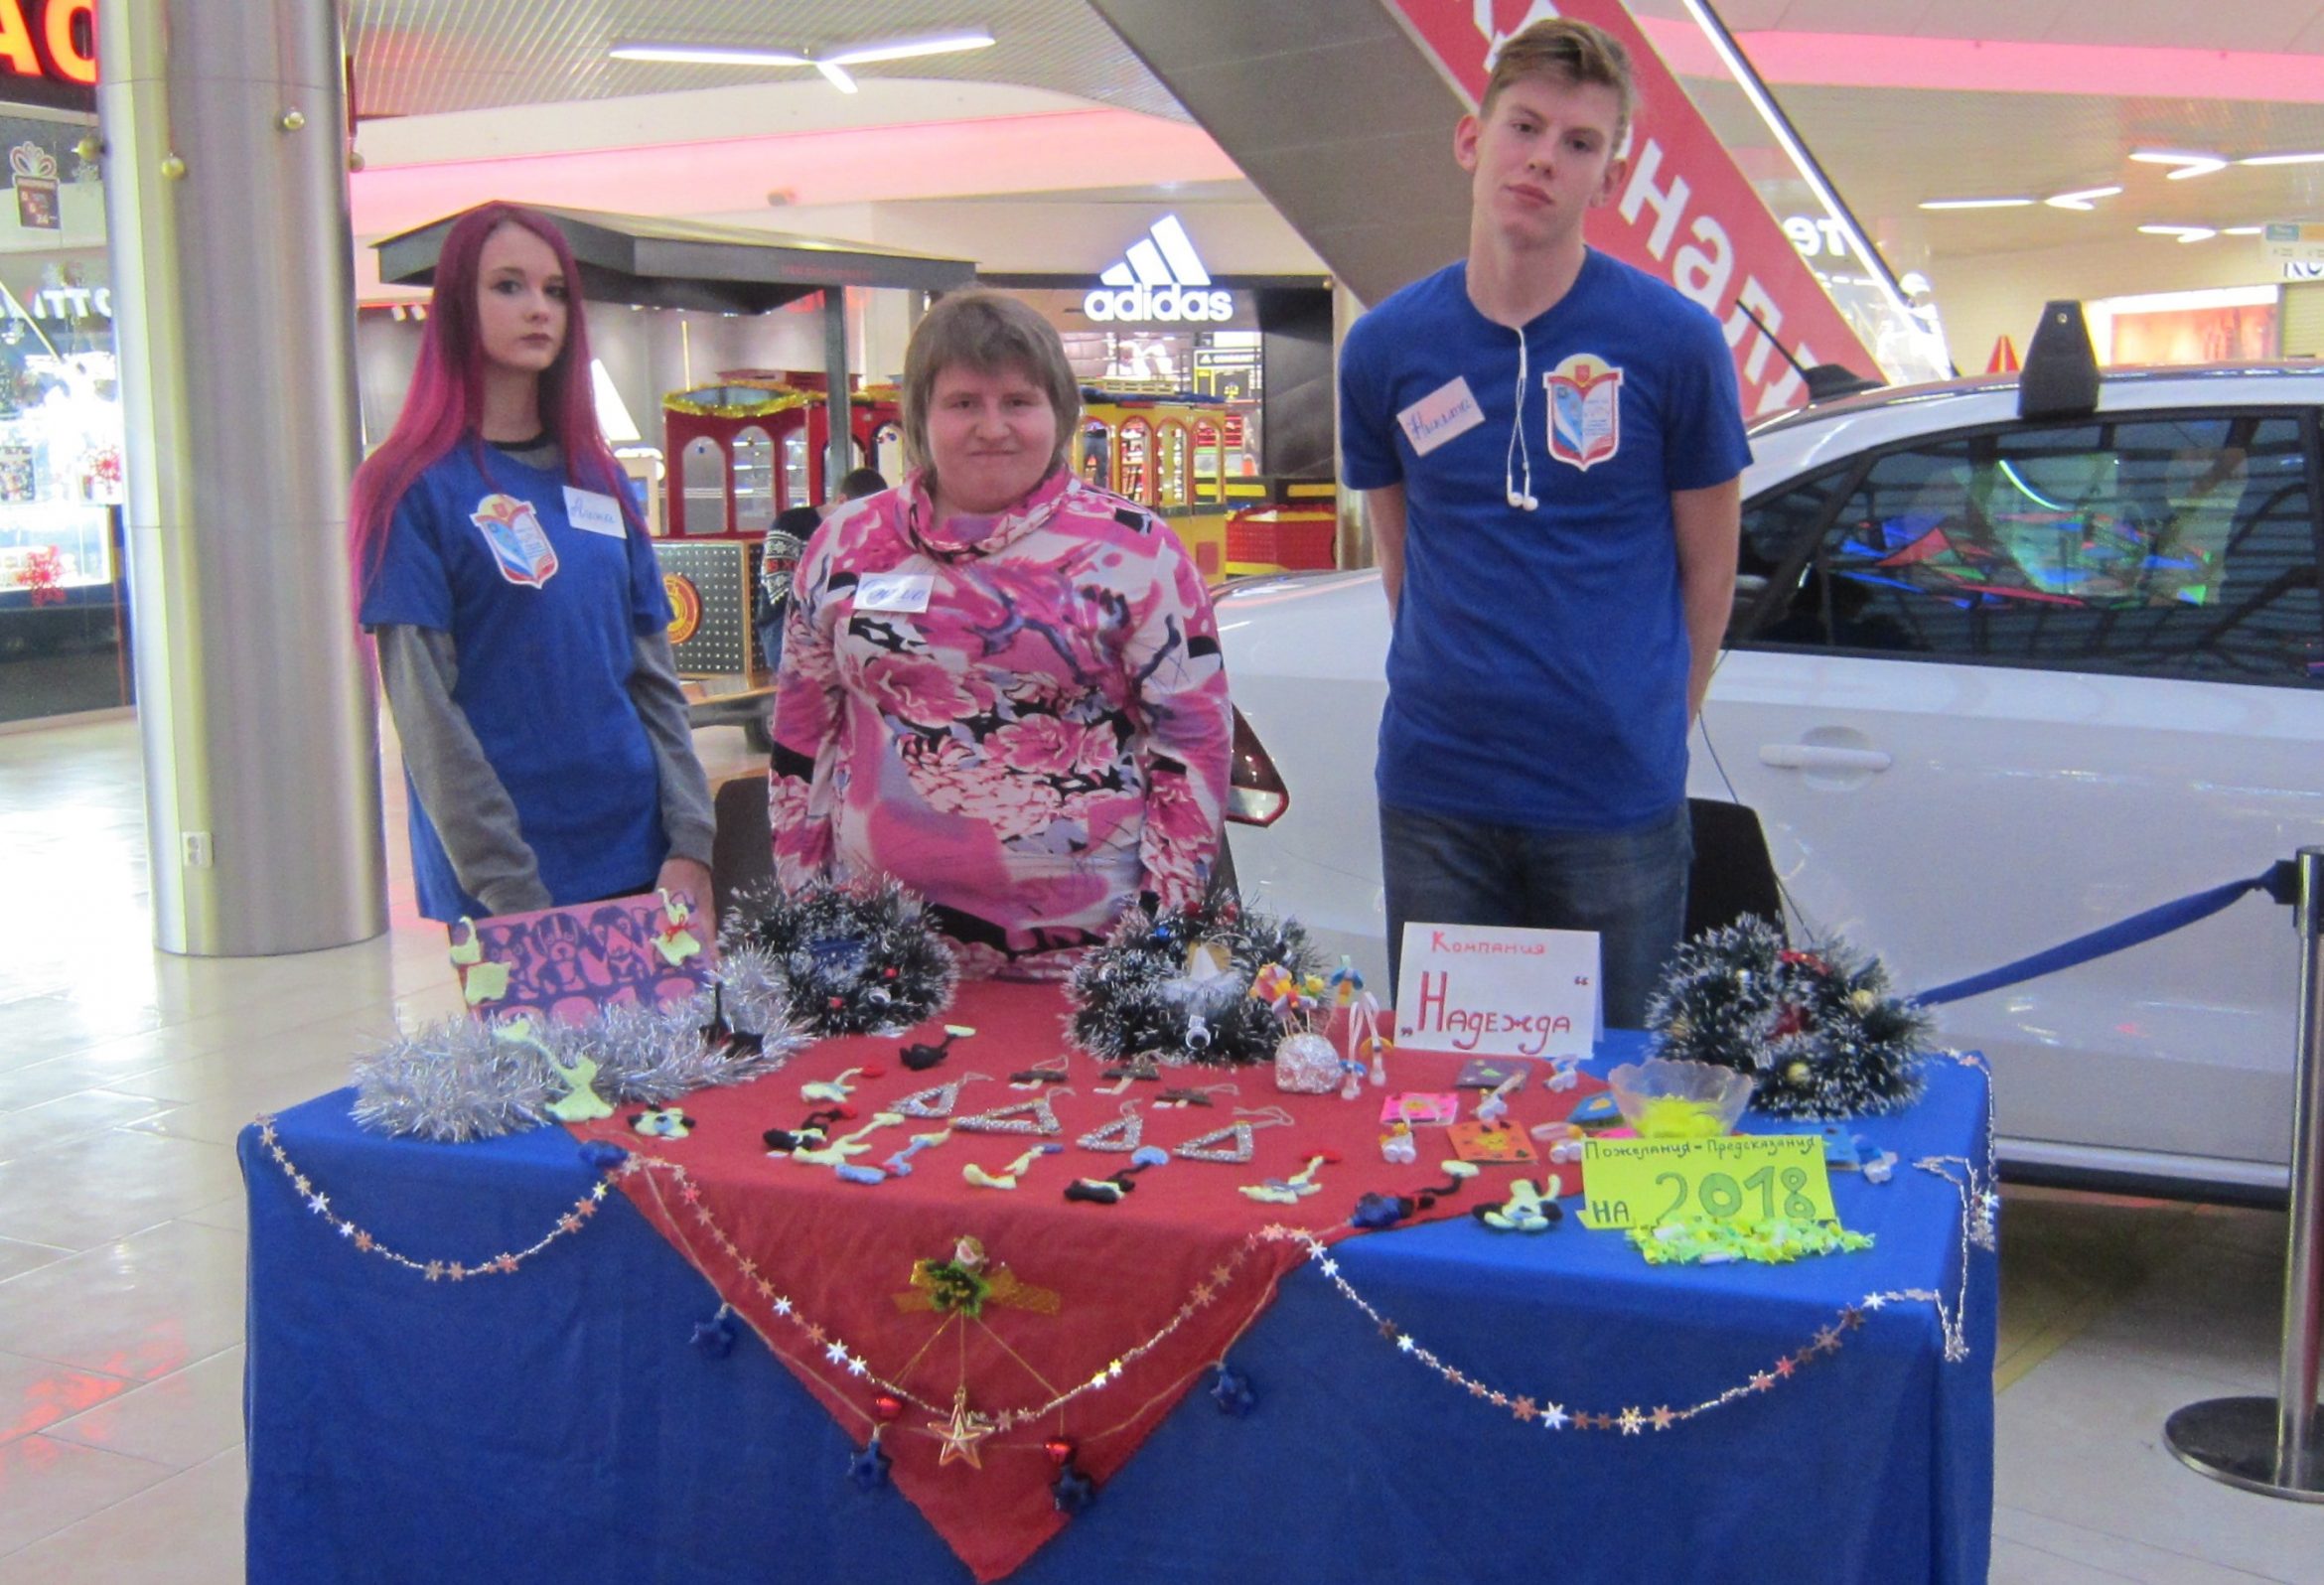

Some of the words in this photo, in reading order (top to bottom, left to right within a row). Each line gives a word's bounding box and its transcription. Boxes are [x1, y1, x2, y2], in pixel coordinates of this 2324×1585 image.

[1084, 284, 1234, 322] adidas
[1431, 931, 1546, 954] Компания
[1655, 1165, 1816, 1227] 2018
